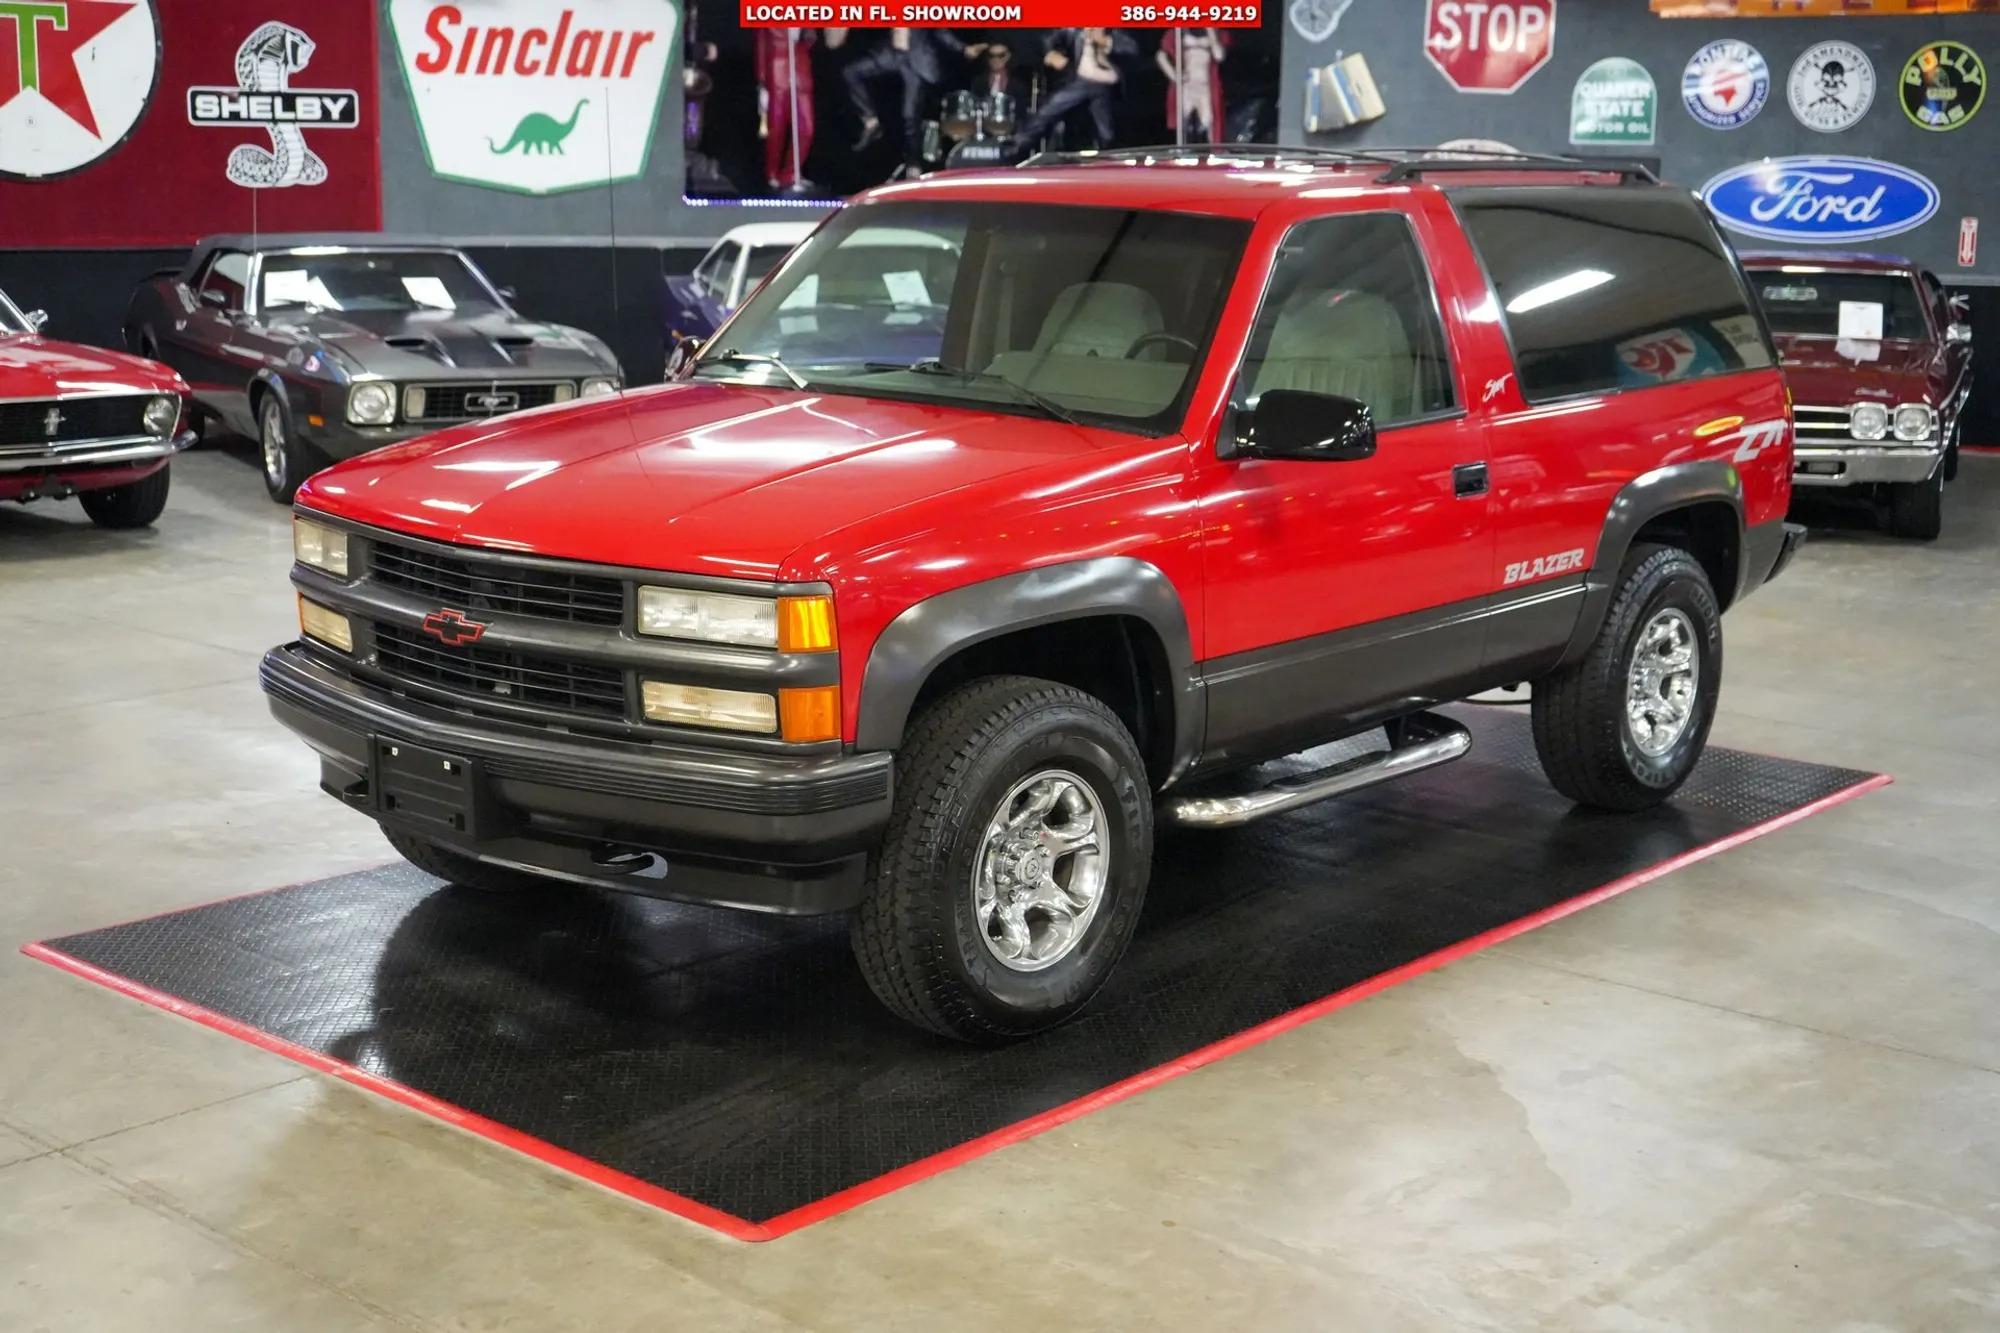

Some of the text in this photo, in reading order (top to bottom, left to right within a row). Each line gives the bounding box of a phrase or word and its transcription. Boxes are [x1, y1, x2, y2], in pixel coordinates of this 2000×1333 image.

[415, 5, 655, 78] Sinclair
[1437, 2, 1546, 53] STOP
[1905, 46, 1982, 86] POLLY
[194, 94, 349, 121] SHELBY
[1576, 121, 1624, 133] OTOR
[1750, 170, 1886, 222] Ford
[1503, 548, 1584, 585] BLAZER
